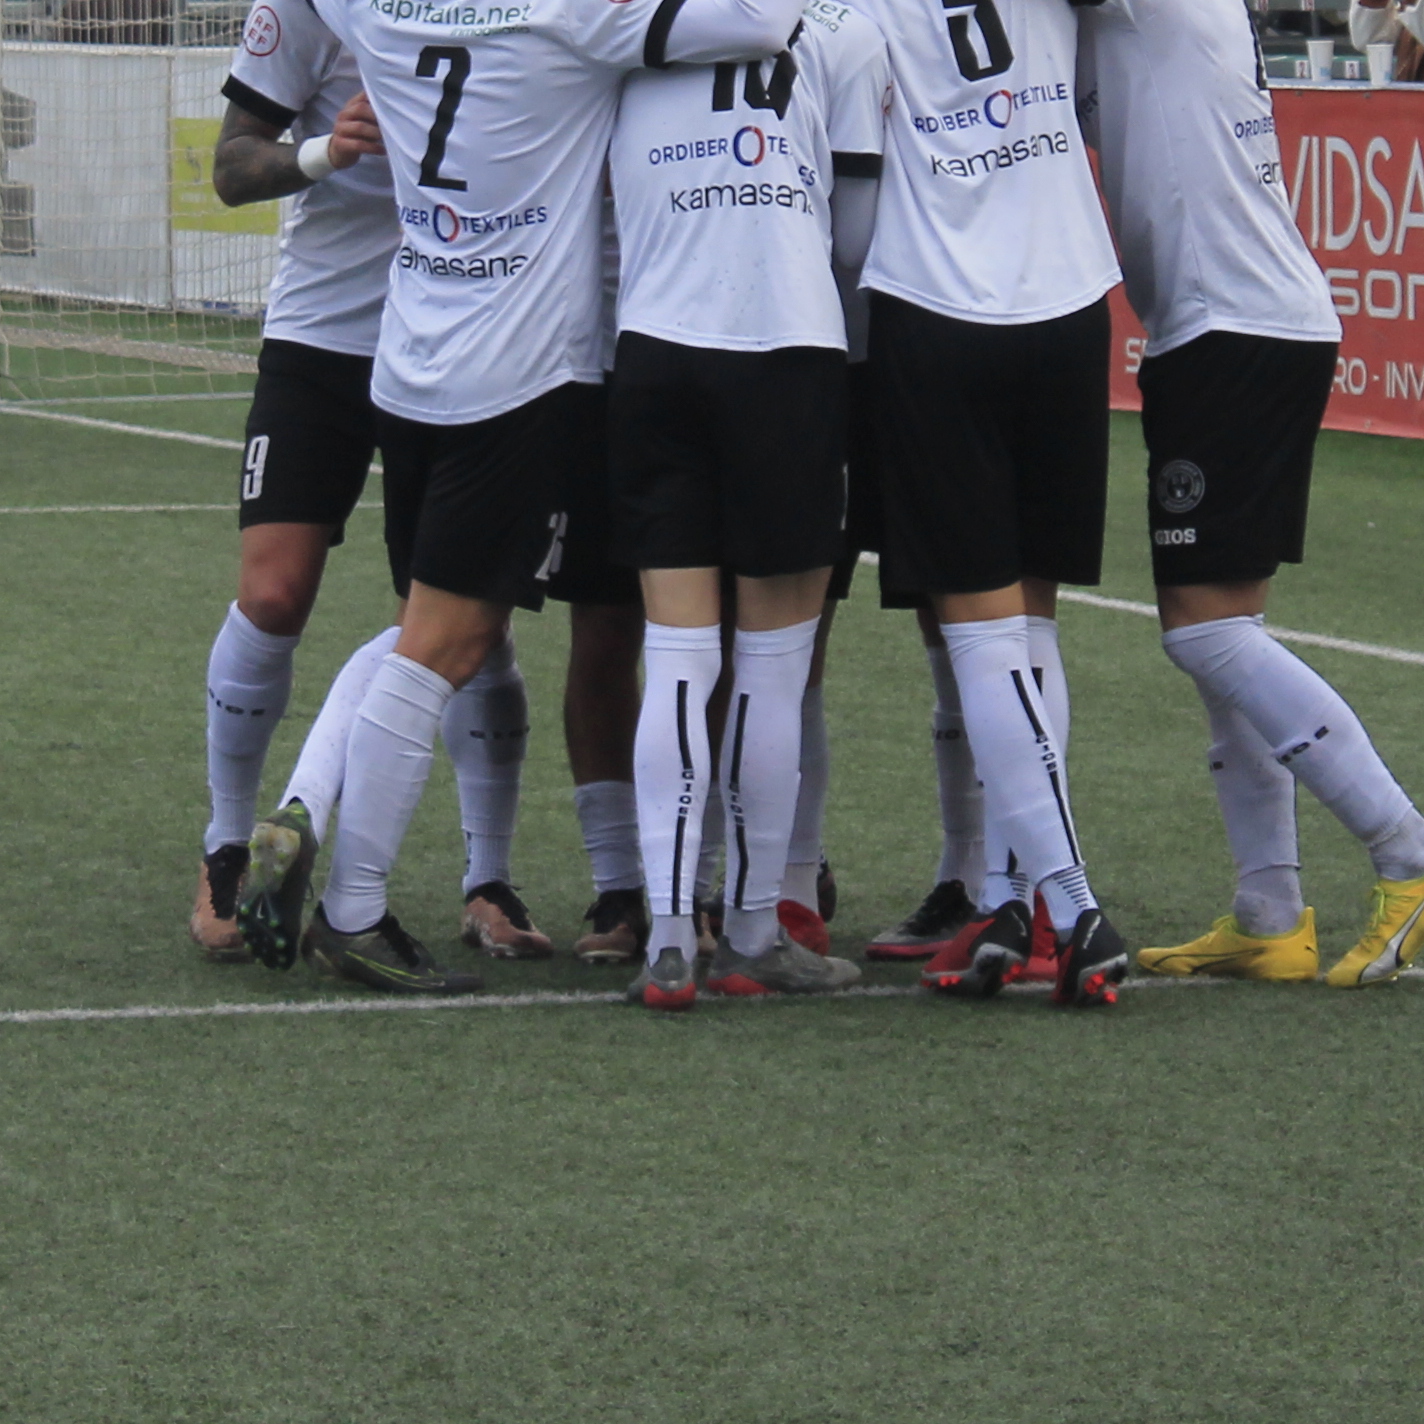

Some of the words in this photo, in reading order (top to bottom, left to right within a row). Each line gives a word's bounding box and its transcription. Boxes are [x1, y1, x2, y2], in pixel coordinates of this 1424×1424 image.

[415, 46, 472, 192] 2
[913, 109, 981, 133] RDIBER
[649, 138, 728, 166] ORDIBER
[671, 182, 813, 214] kamasan
[461, 206, 548, 234] TEXTILES
[401, 246, 529, 279] amasana
[243, 435, 270, 501] 9
[1155, 528, 1197, 545] GIOS
